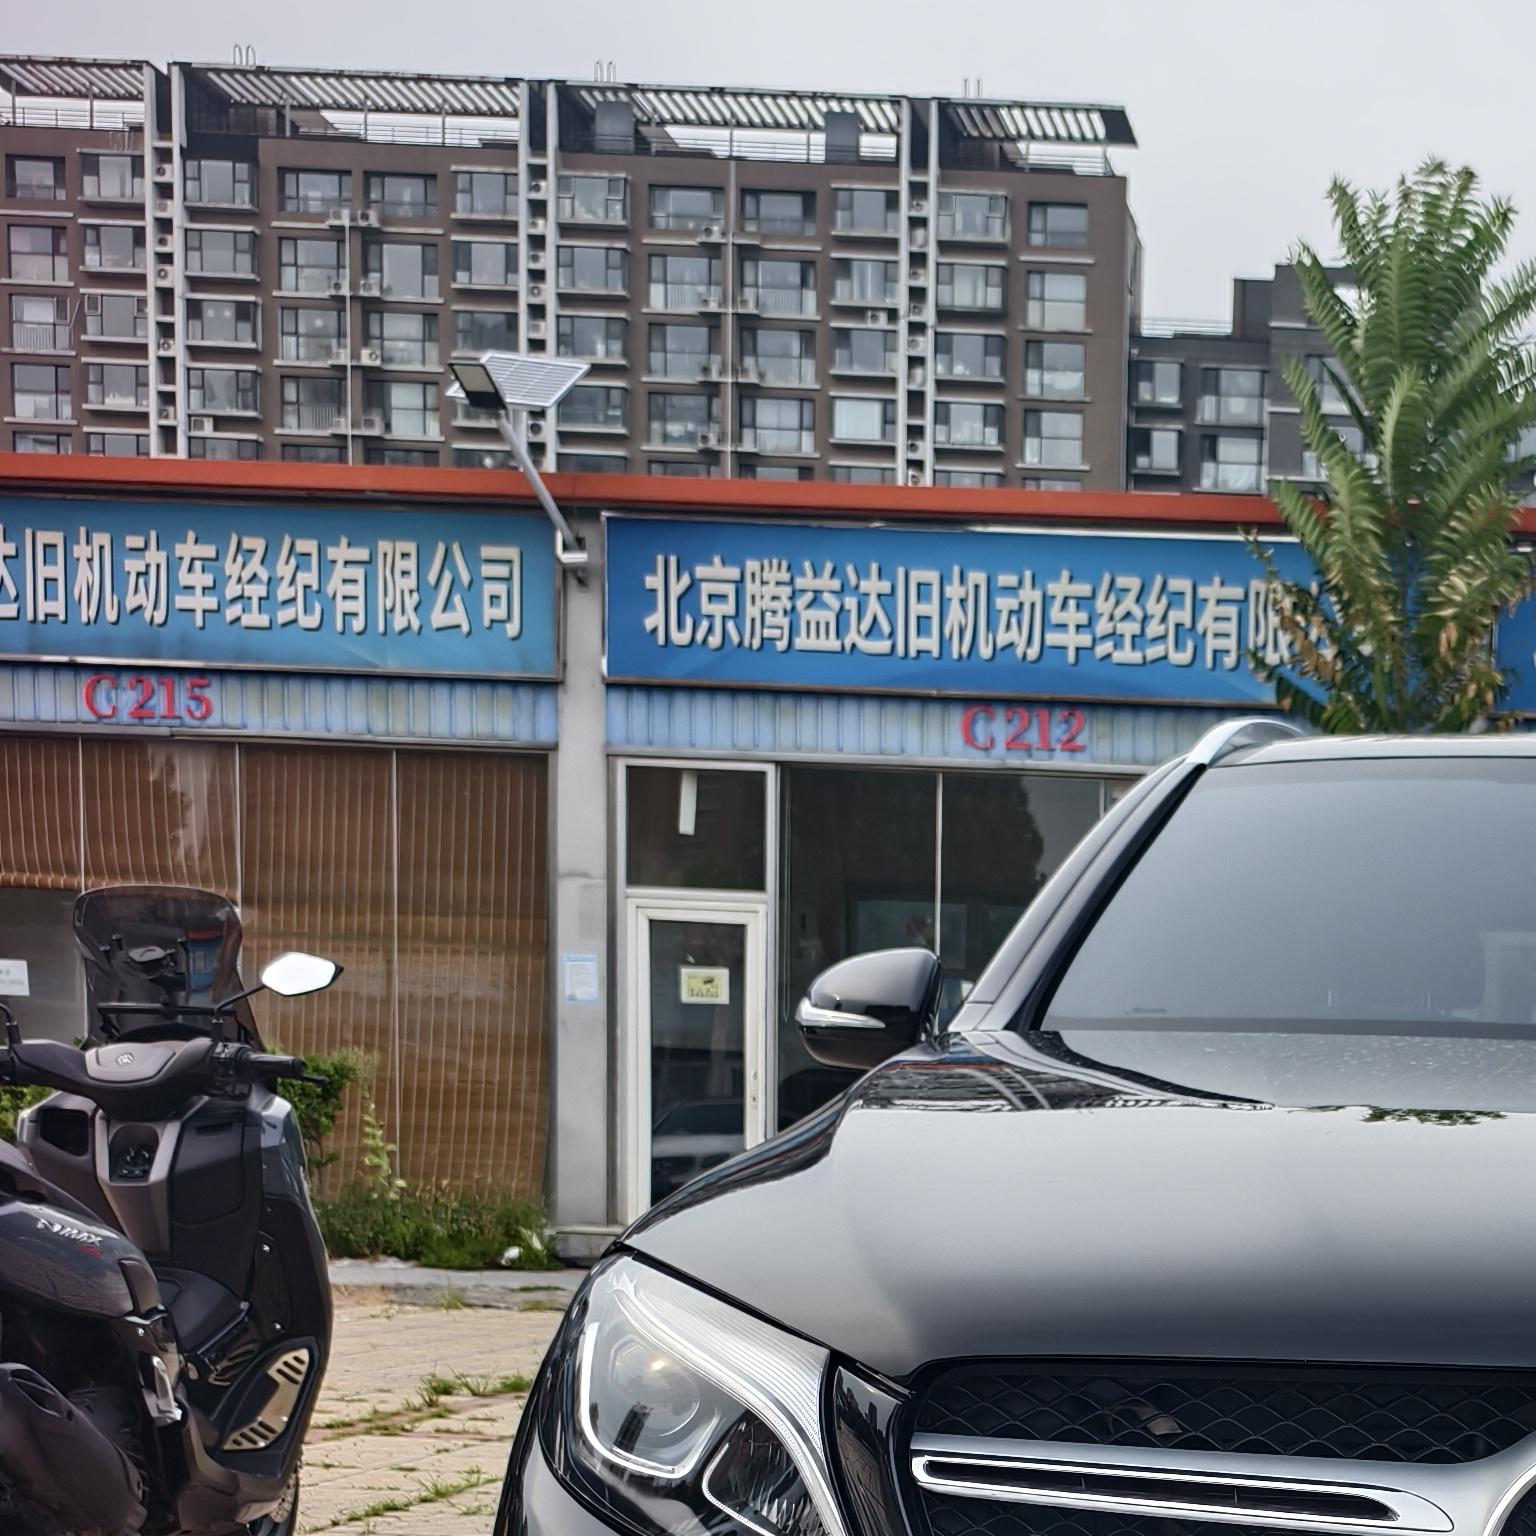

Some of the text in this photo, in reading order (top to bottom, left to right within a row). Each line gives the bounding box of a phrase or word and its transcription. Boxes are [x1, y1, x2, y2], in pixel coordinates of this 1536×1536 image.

[643, 553, 1372, 670] 北京腾益达旧机动车经纪有限
